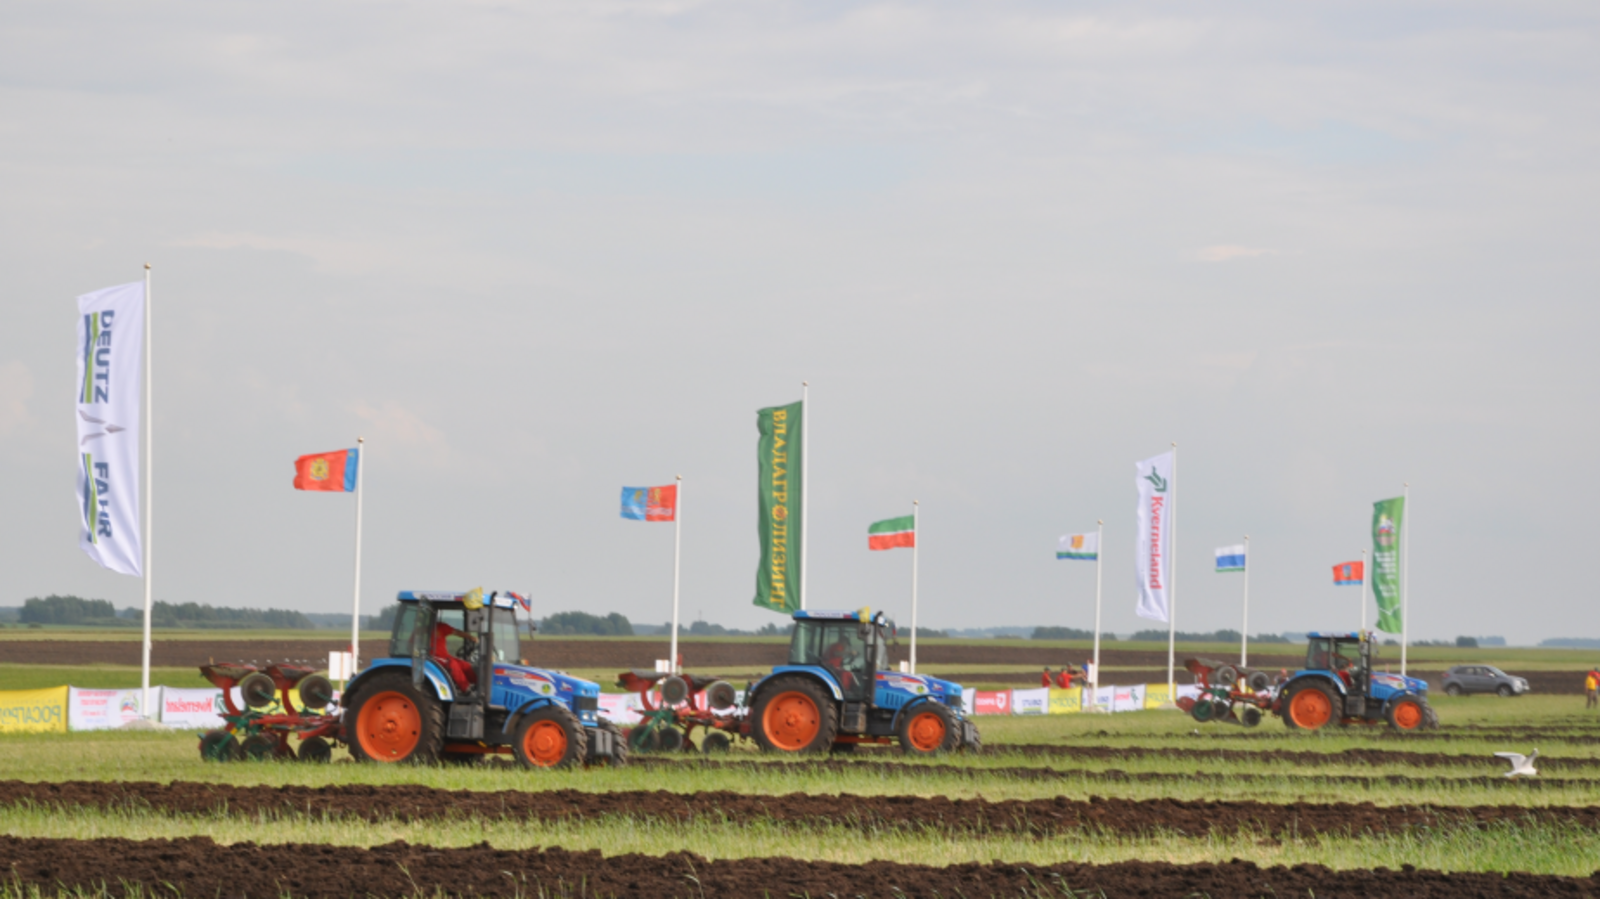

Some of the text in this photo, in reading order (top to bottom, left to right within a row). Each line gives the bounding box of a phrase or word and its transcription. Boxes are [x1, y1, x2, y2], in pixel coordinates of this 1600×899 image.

[94, 309, 115, 404] DEUTZ
[94, 461, 113, 539] FAHR
[1150, 496, 1164, 590] Kverneland
